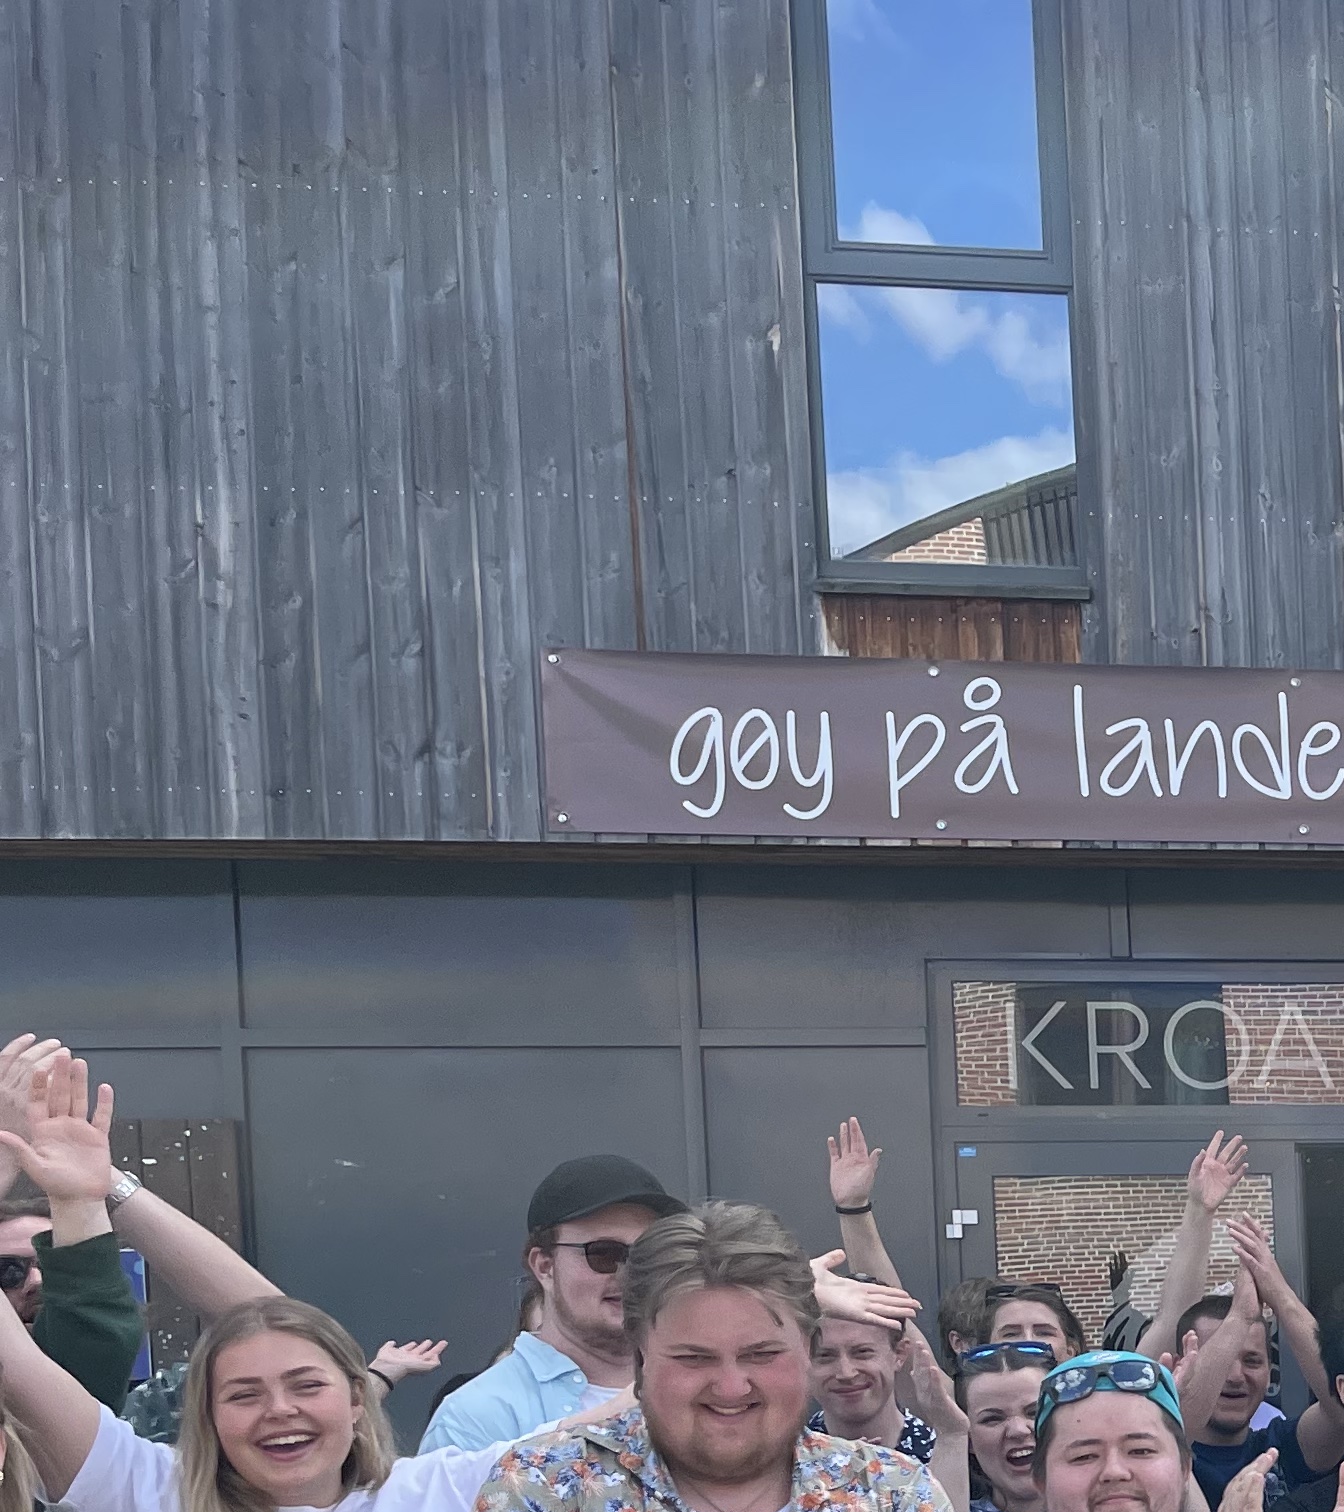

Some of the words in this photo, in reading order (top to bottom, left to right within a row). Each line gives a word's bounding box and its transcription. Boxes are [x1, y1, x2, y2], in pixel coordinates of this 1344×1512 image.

[669, 705, 834, 821] gøy
[885, 675, 1020, 819] på
[1006, 1000, 1337, 1090] KROA
